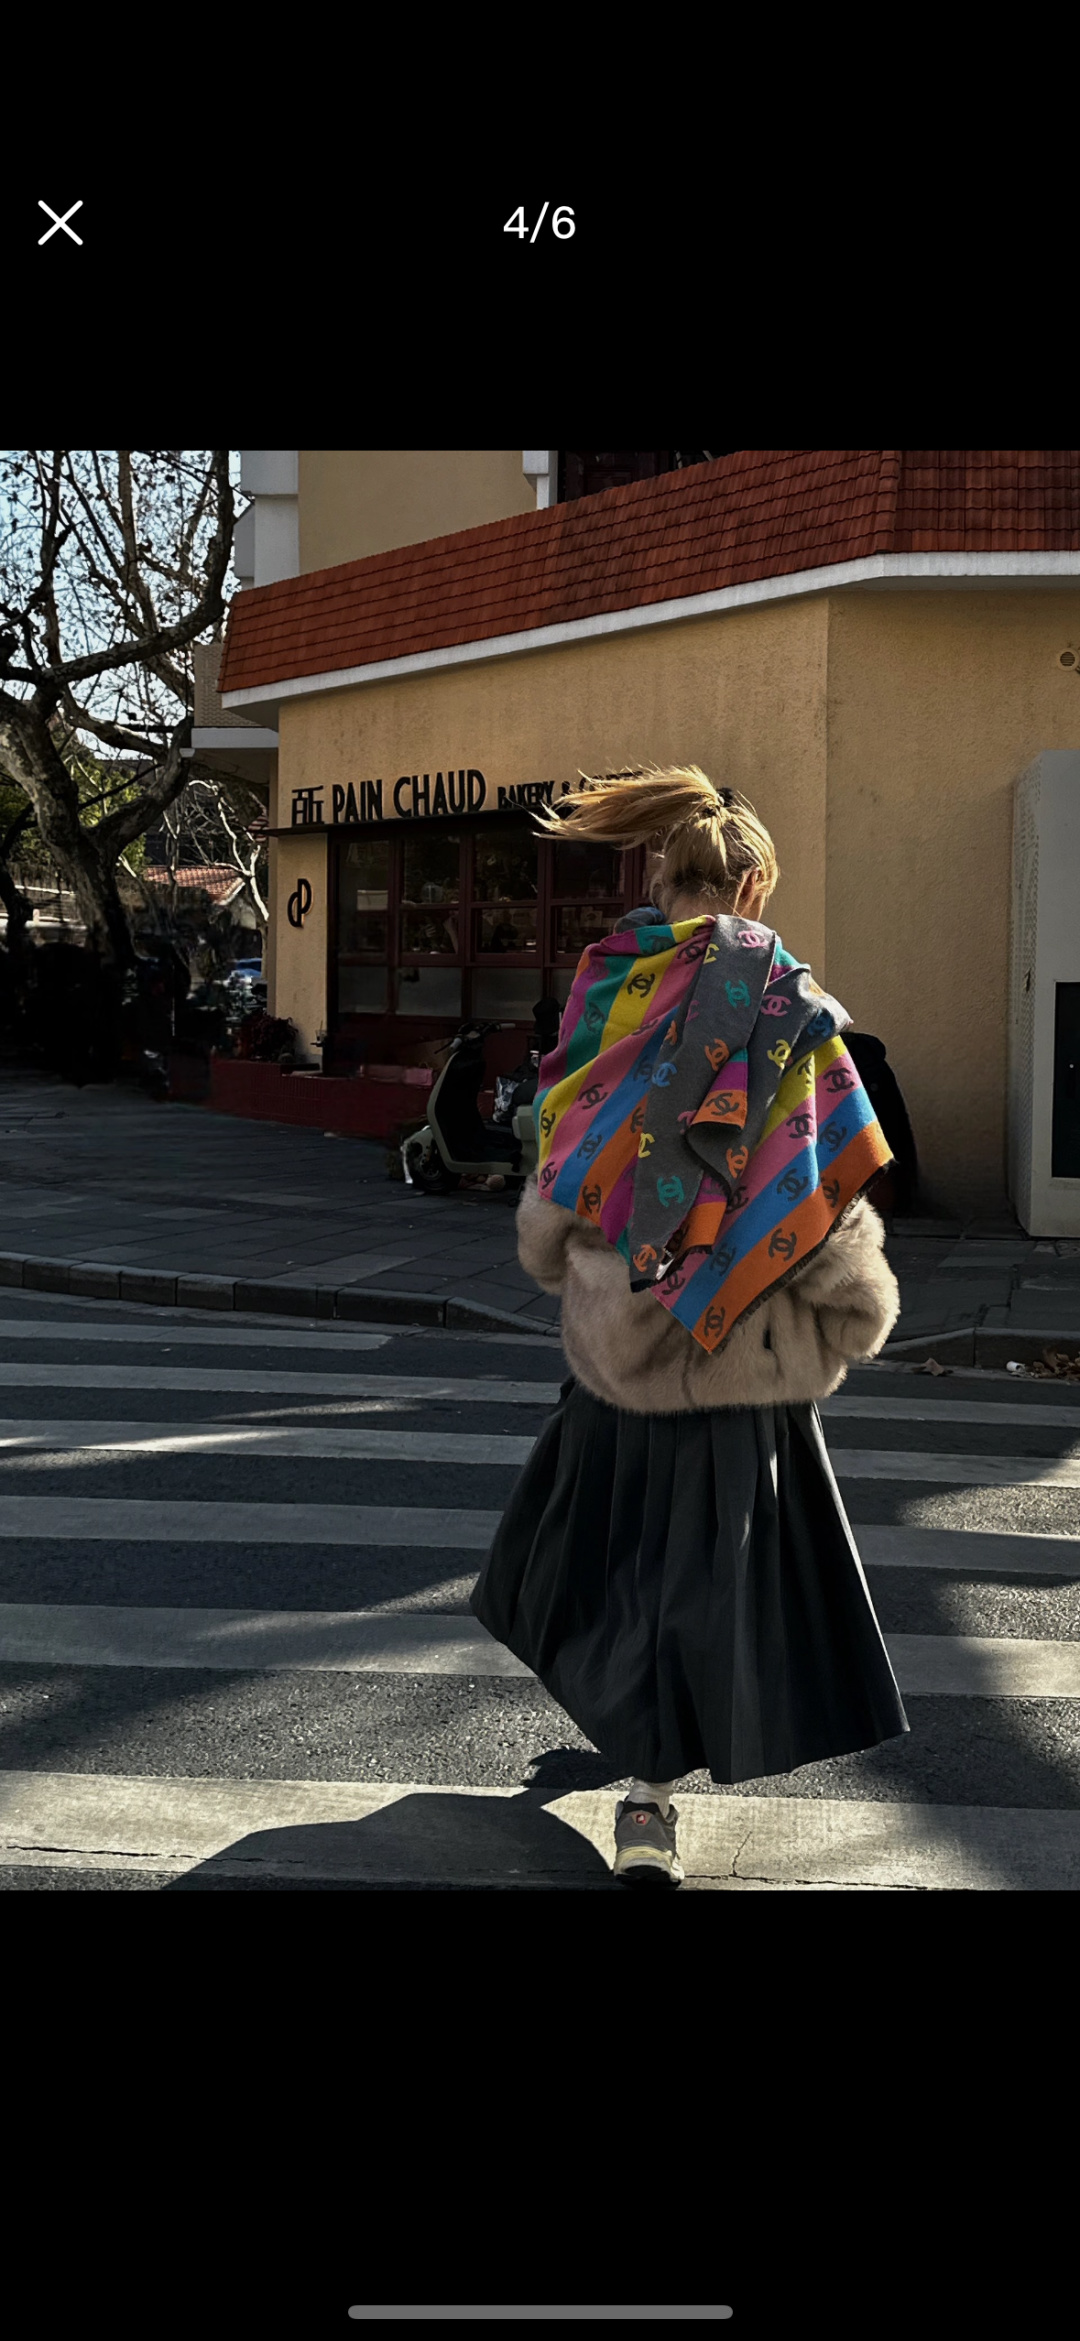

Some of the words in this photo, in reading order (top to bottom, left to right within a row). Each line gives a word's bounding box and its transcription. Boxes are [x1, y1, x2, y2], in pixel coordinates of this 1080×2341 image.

[332, 779, 383, 824] PAIN
[393, 769, 486, 818] CHAUD
[497, 780, 555, 810] BAKERY
